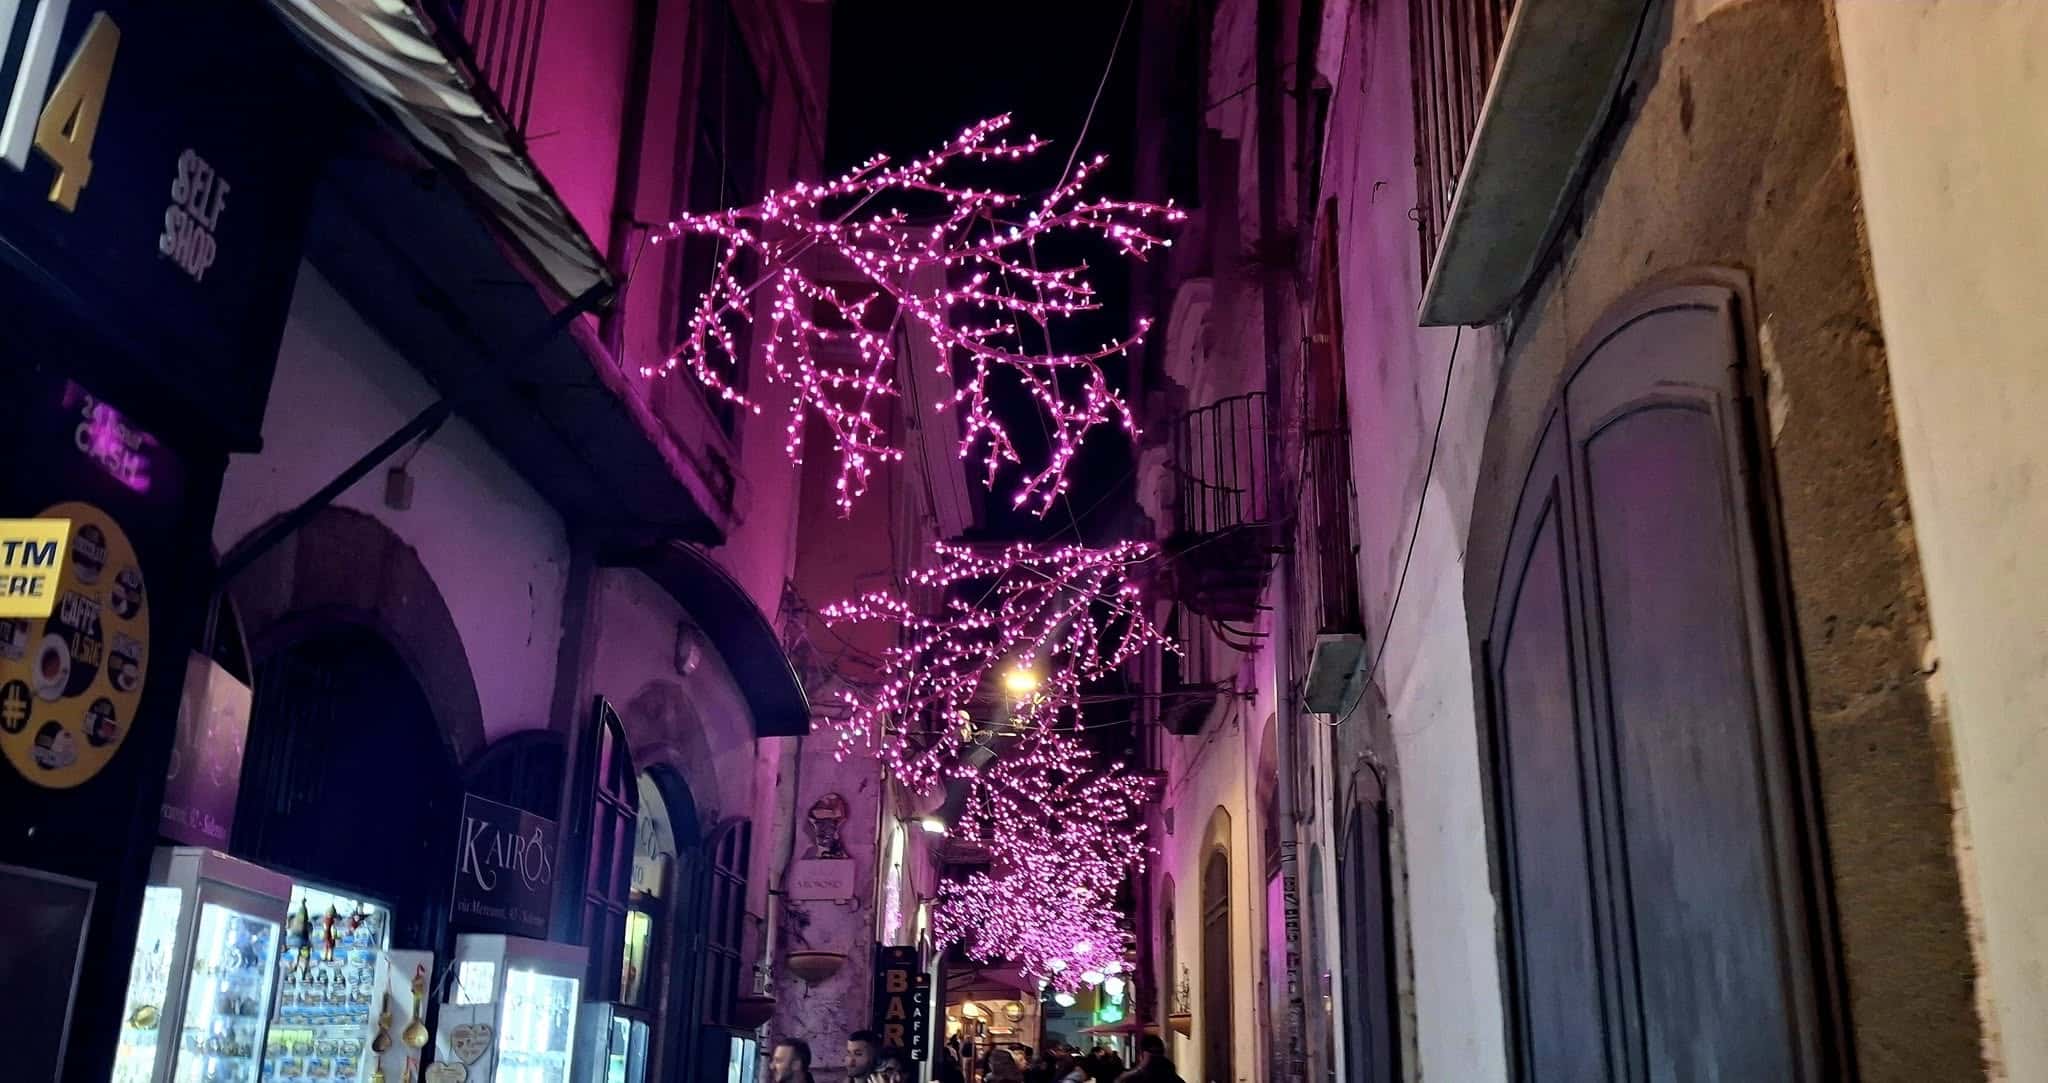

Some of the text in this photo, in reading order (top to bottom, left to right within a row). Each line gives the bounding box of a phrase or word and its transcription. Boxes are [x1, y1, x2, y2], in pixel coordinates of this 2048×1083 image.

[171, 148, 231, 233] SELF
[159, 204, 217, 282] SHOP
[75, 421, 141, 484] CASH
[884, 968, 908, 1048] BAR
